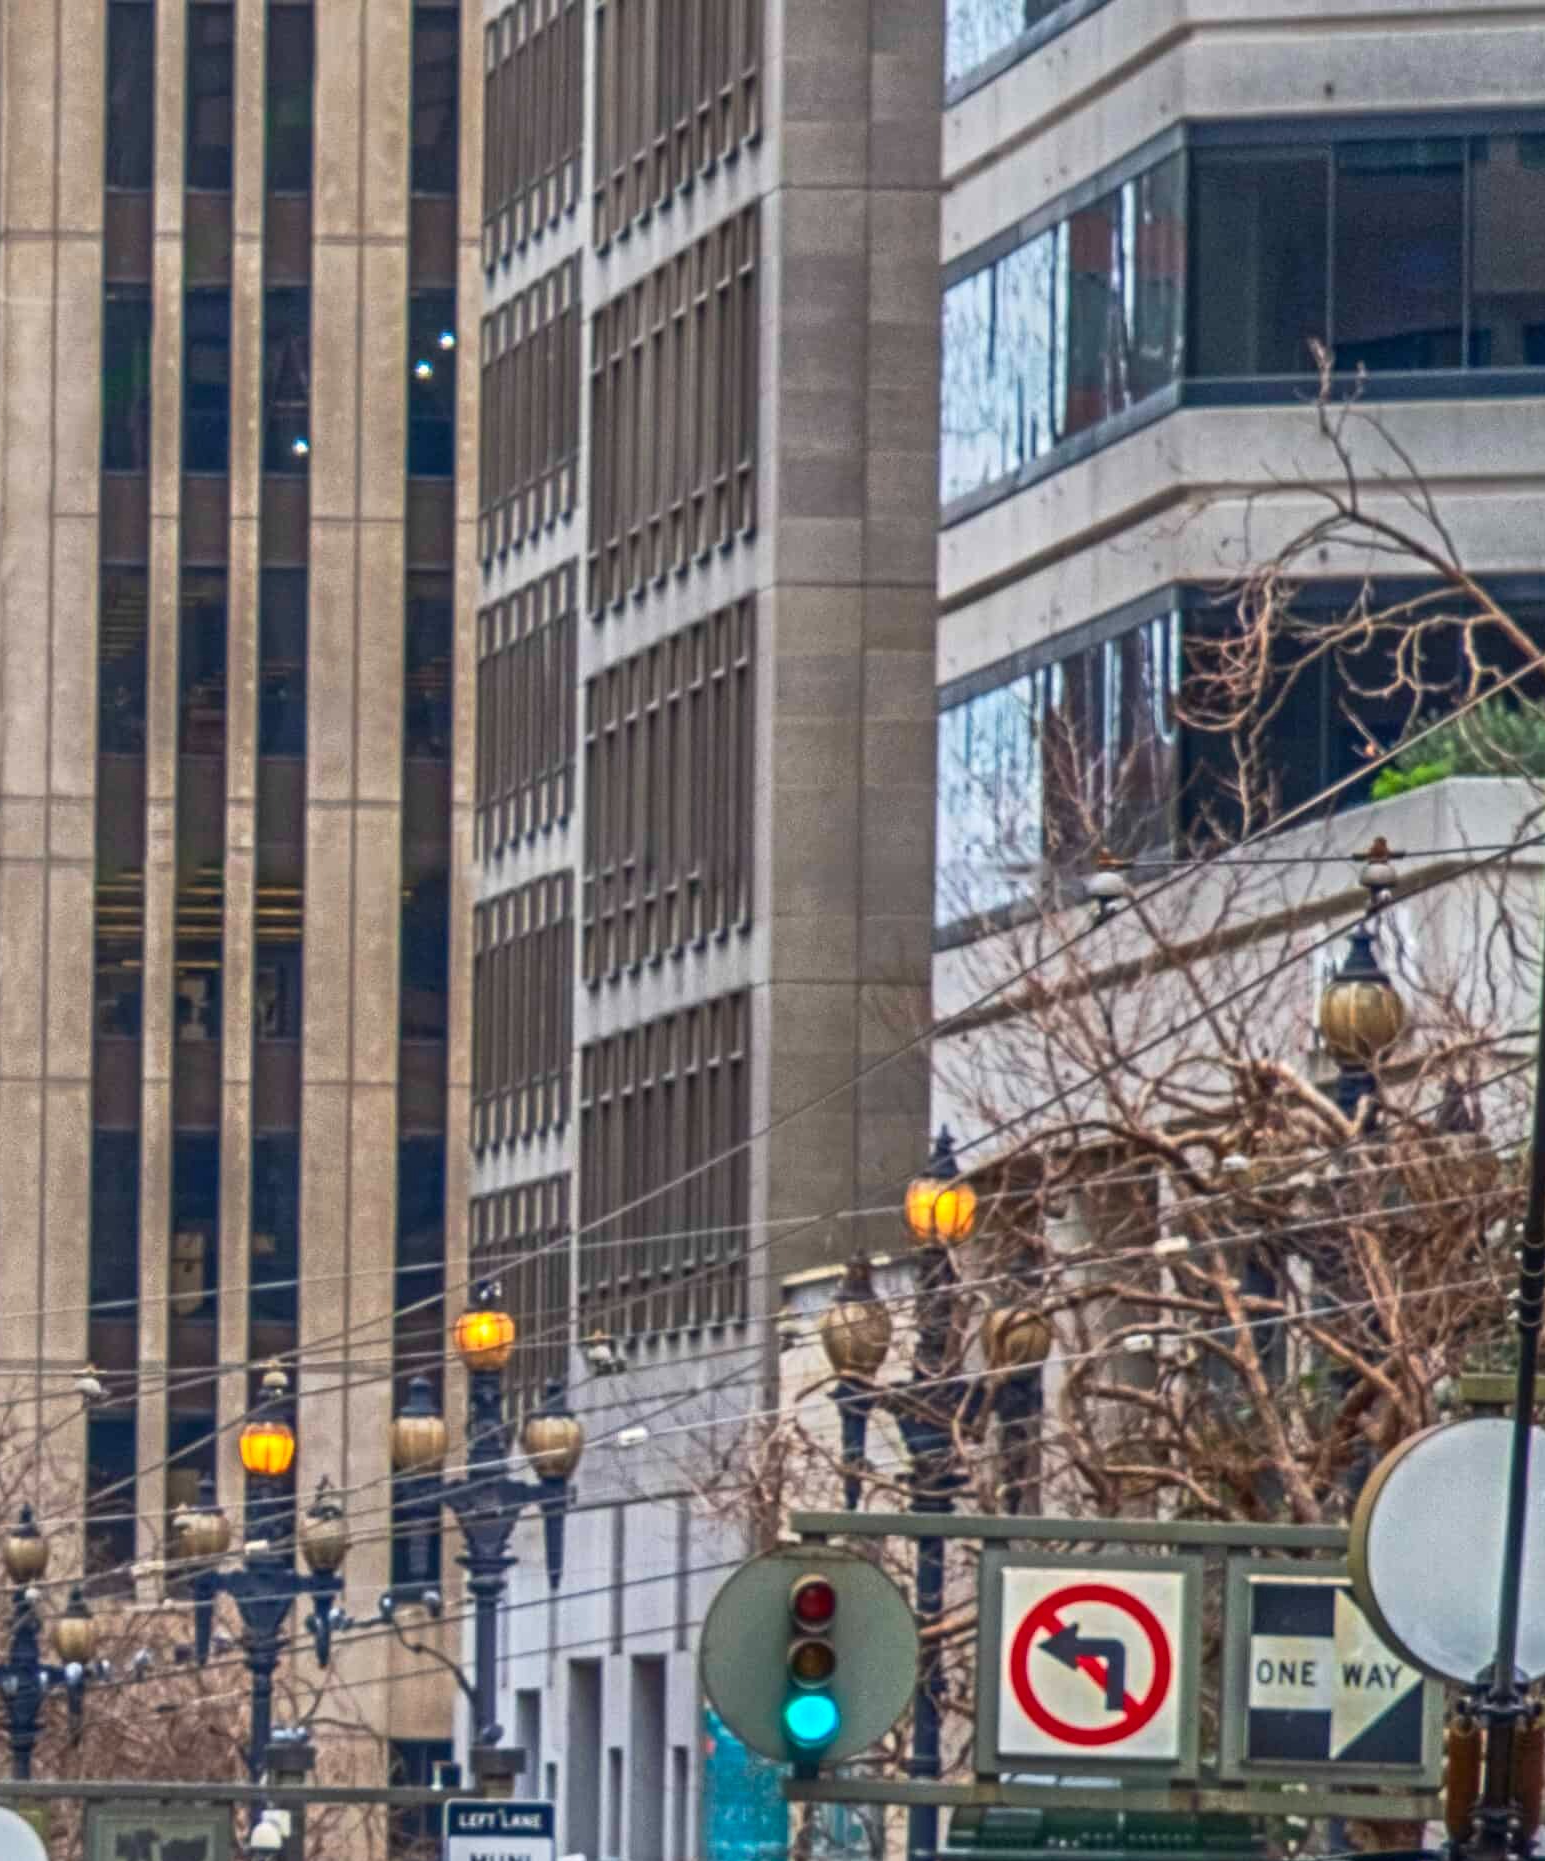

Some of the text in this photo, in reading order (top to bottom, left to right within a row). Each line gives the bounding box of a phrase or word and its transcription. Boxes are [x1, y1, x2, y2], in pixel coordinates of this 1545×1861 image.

[1255, 1658, 1407, 1691] ONE WAY
[458, 1812, 543, 1829] LEFT LANE
